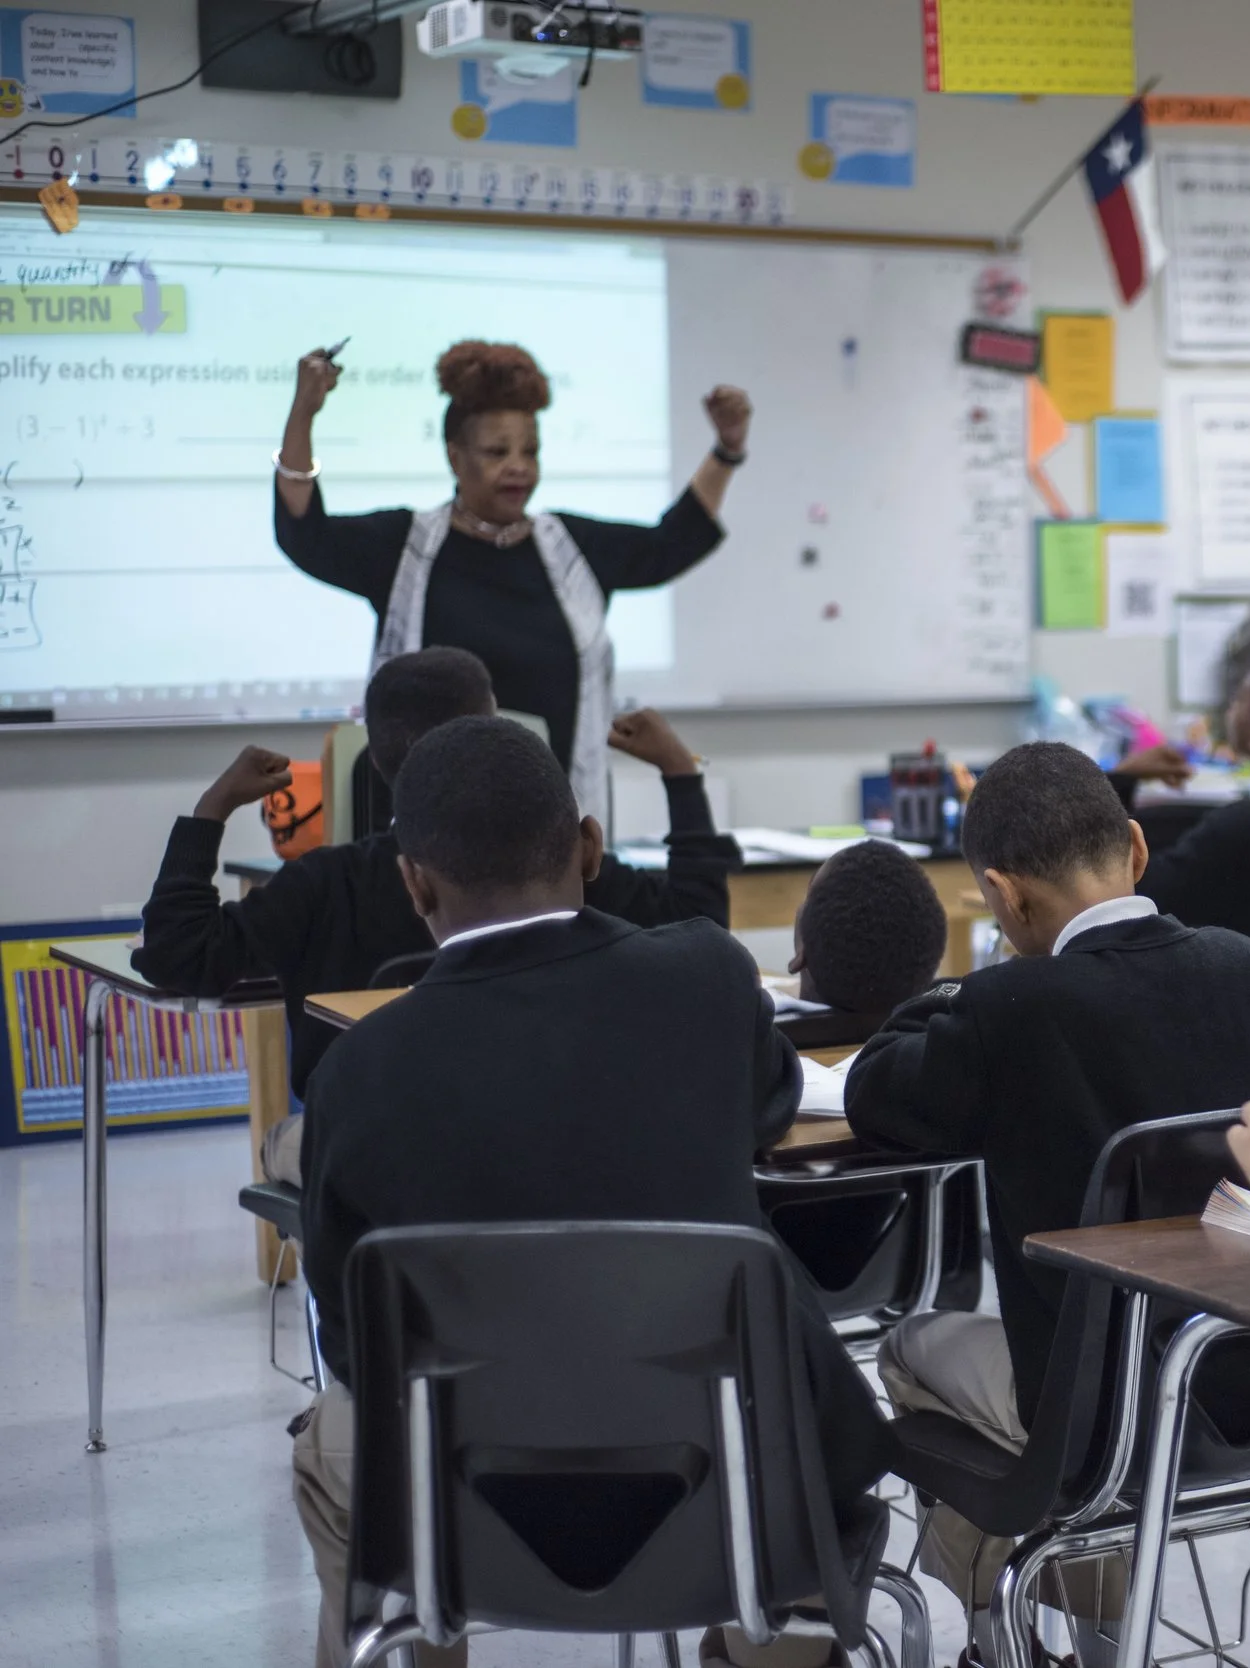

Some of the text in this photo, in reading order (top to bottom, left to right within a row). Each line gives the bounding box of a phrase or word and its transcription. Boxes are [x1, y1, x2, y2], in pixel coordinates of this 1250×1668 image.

[30, 41, 55, 50] about
[31, 54, 64, 64] content
[31, 68, 78, 77] and how to
[50, 146, 64, 168] 0
[126, 150, 140, 171] 2
[236, 156, 251, 178] 5
[273, 159, 287, 180] 6
[310, 160, 323, 182] 7
[343, 163, 358, 186] 8
[378, 164, 393, 189] 9
[412, 166, 433, 190] 10
[17, 257, 100, 294] quantity
[26, 296, 112, 323] TURN
[0, 355, 51, 385] plify
[58, 357, 115, 381] each
[122, 361, 249, 386] expression
[366, 362, 424, 384] order
